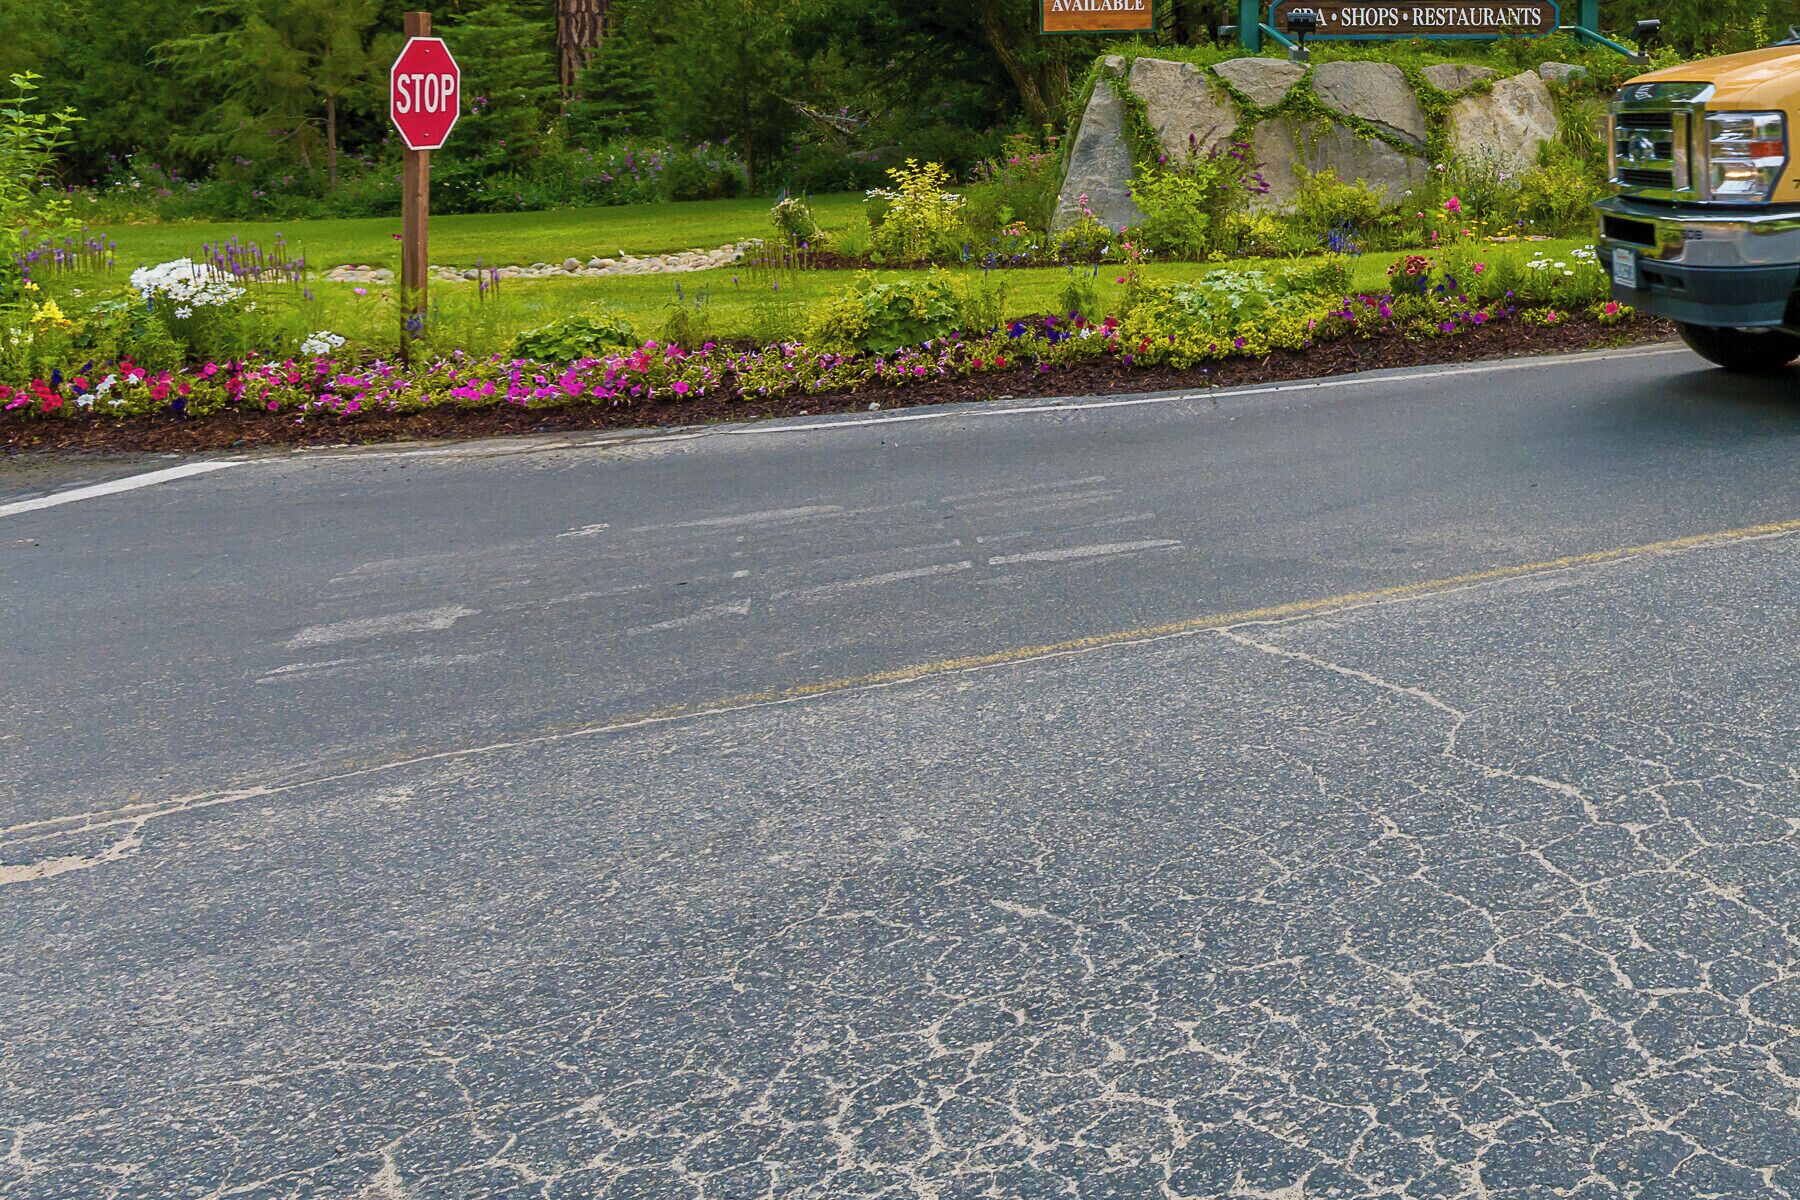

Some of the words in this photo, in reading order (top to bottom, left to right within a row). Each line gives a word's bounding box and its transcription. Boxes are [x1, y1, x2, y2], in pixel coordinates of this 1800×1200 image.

[1341, 7, 1399, 27] SHOPS
[1412, 7, 1541, 26] RESTAURANTS
[396, 73, 455, 114] STOP
